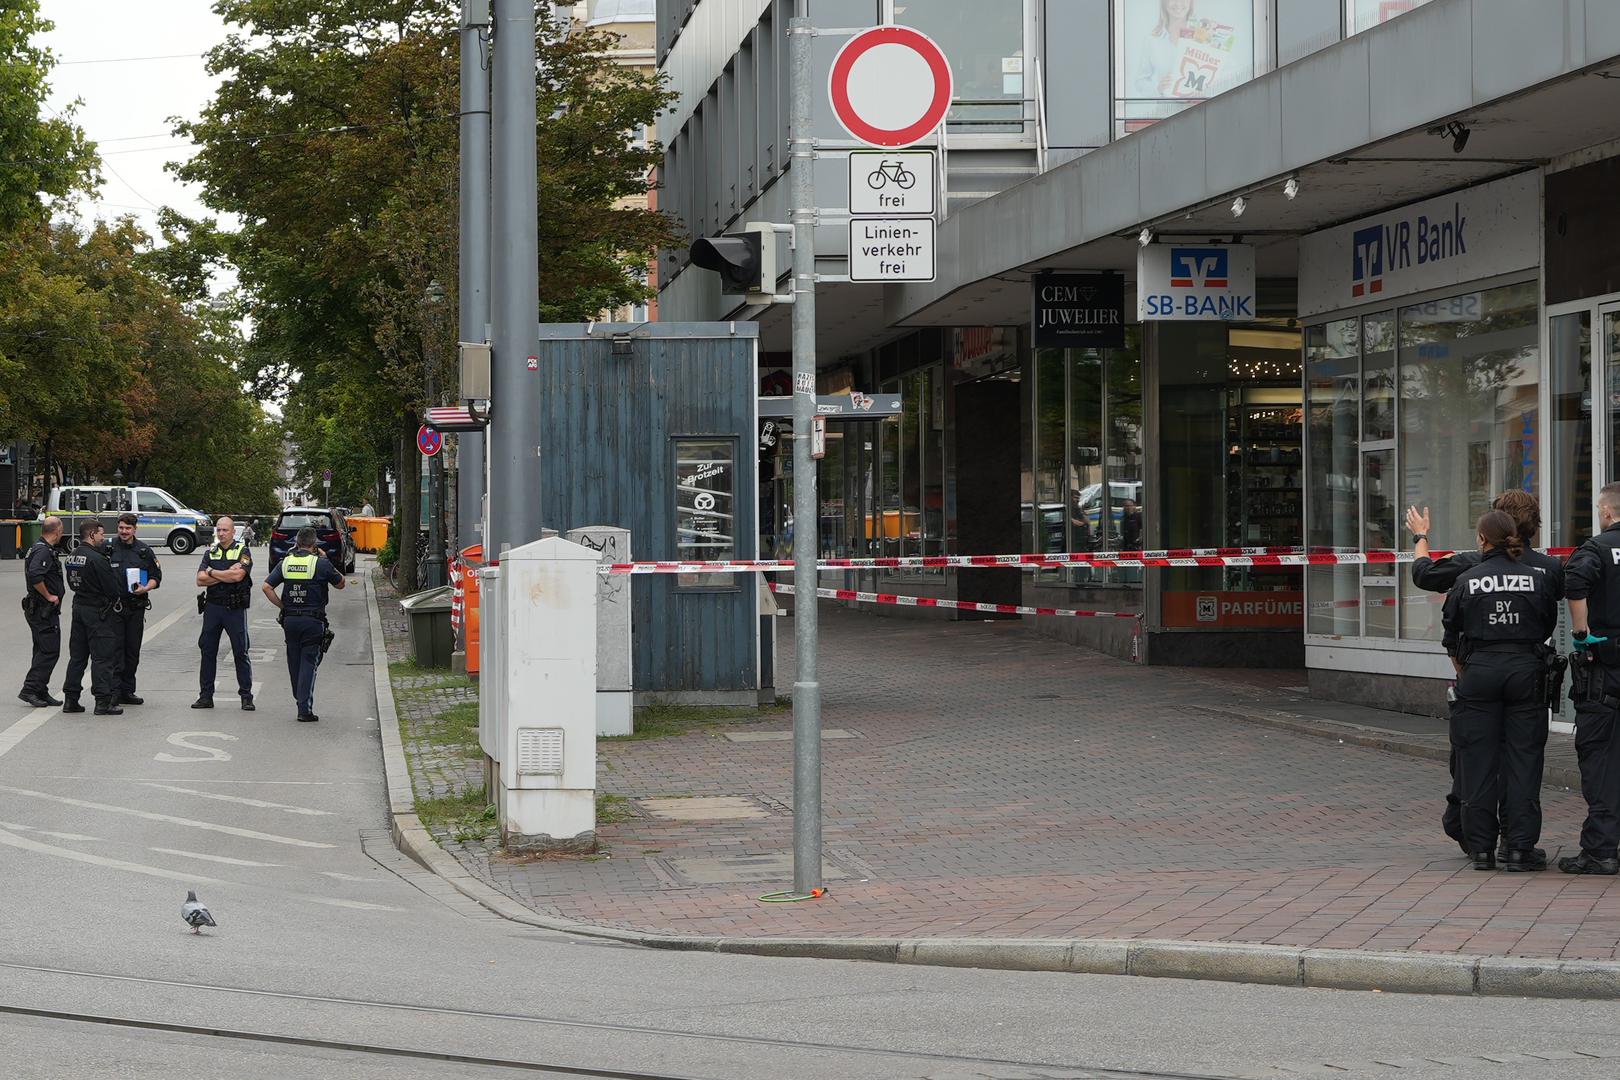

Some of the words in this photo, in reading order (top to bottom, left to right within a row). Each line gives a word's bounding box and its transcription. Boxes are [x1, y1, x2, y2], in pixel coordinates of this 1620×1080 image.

[1184, 46, 1220, 65] Müller
[878, 194, 905, 207] frei
[865, 226, 919, 240] Linien-
[1386, 220, 1411, 272] VR
[1417, 202, 1466, 265] Bank
[862, 243, 922, 256] verkehr
[879, 261, 905, 274] frei
[1041, 286, 1080, 302] CEM
[1146, 295, 1252, 316] SB-BANK
[1039, 308, 1120, 328] JUWELIER
[697, 462, 714, 472] Zur
[687, 466, 724, 484] Brotzeit
[1469, 574, 1534, 594] POLIZEI
[1495, 600, 1512, 613] BY
[1488, 613, 1520, 625] 5411
